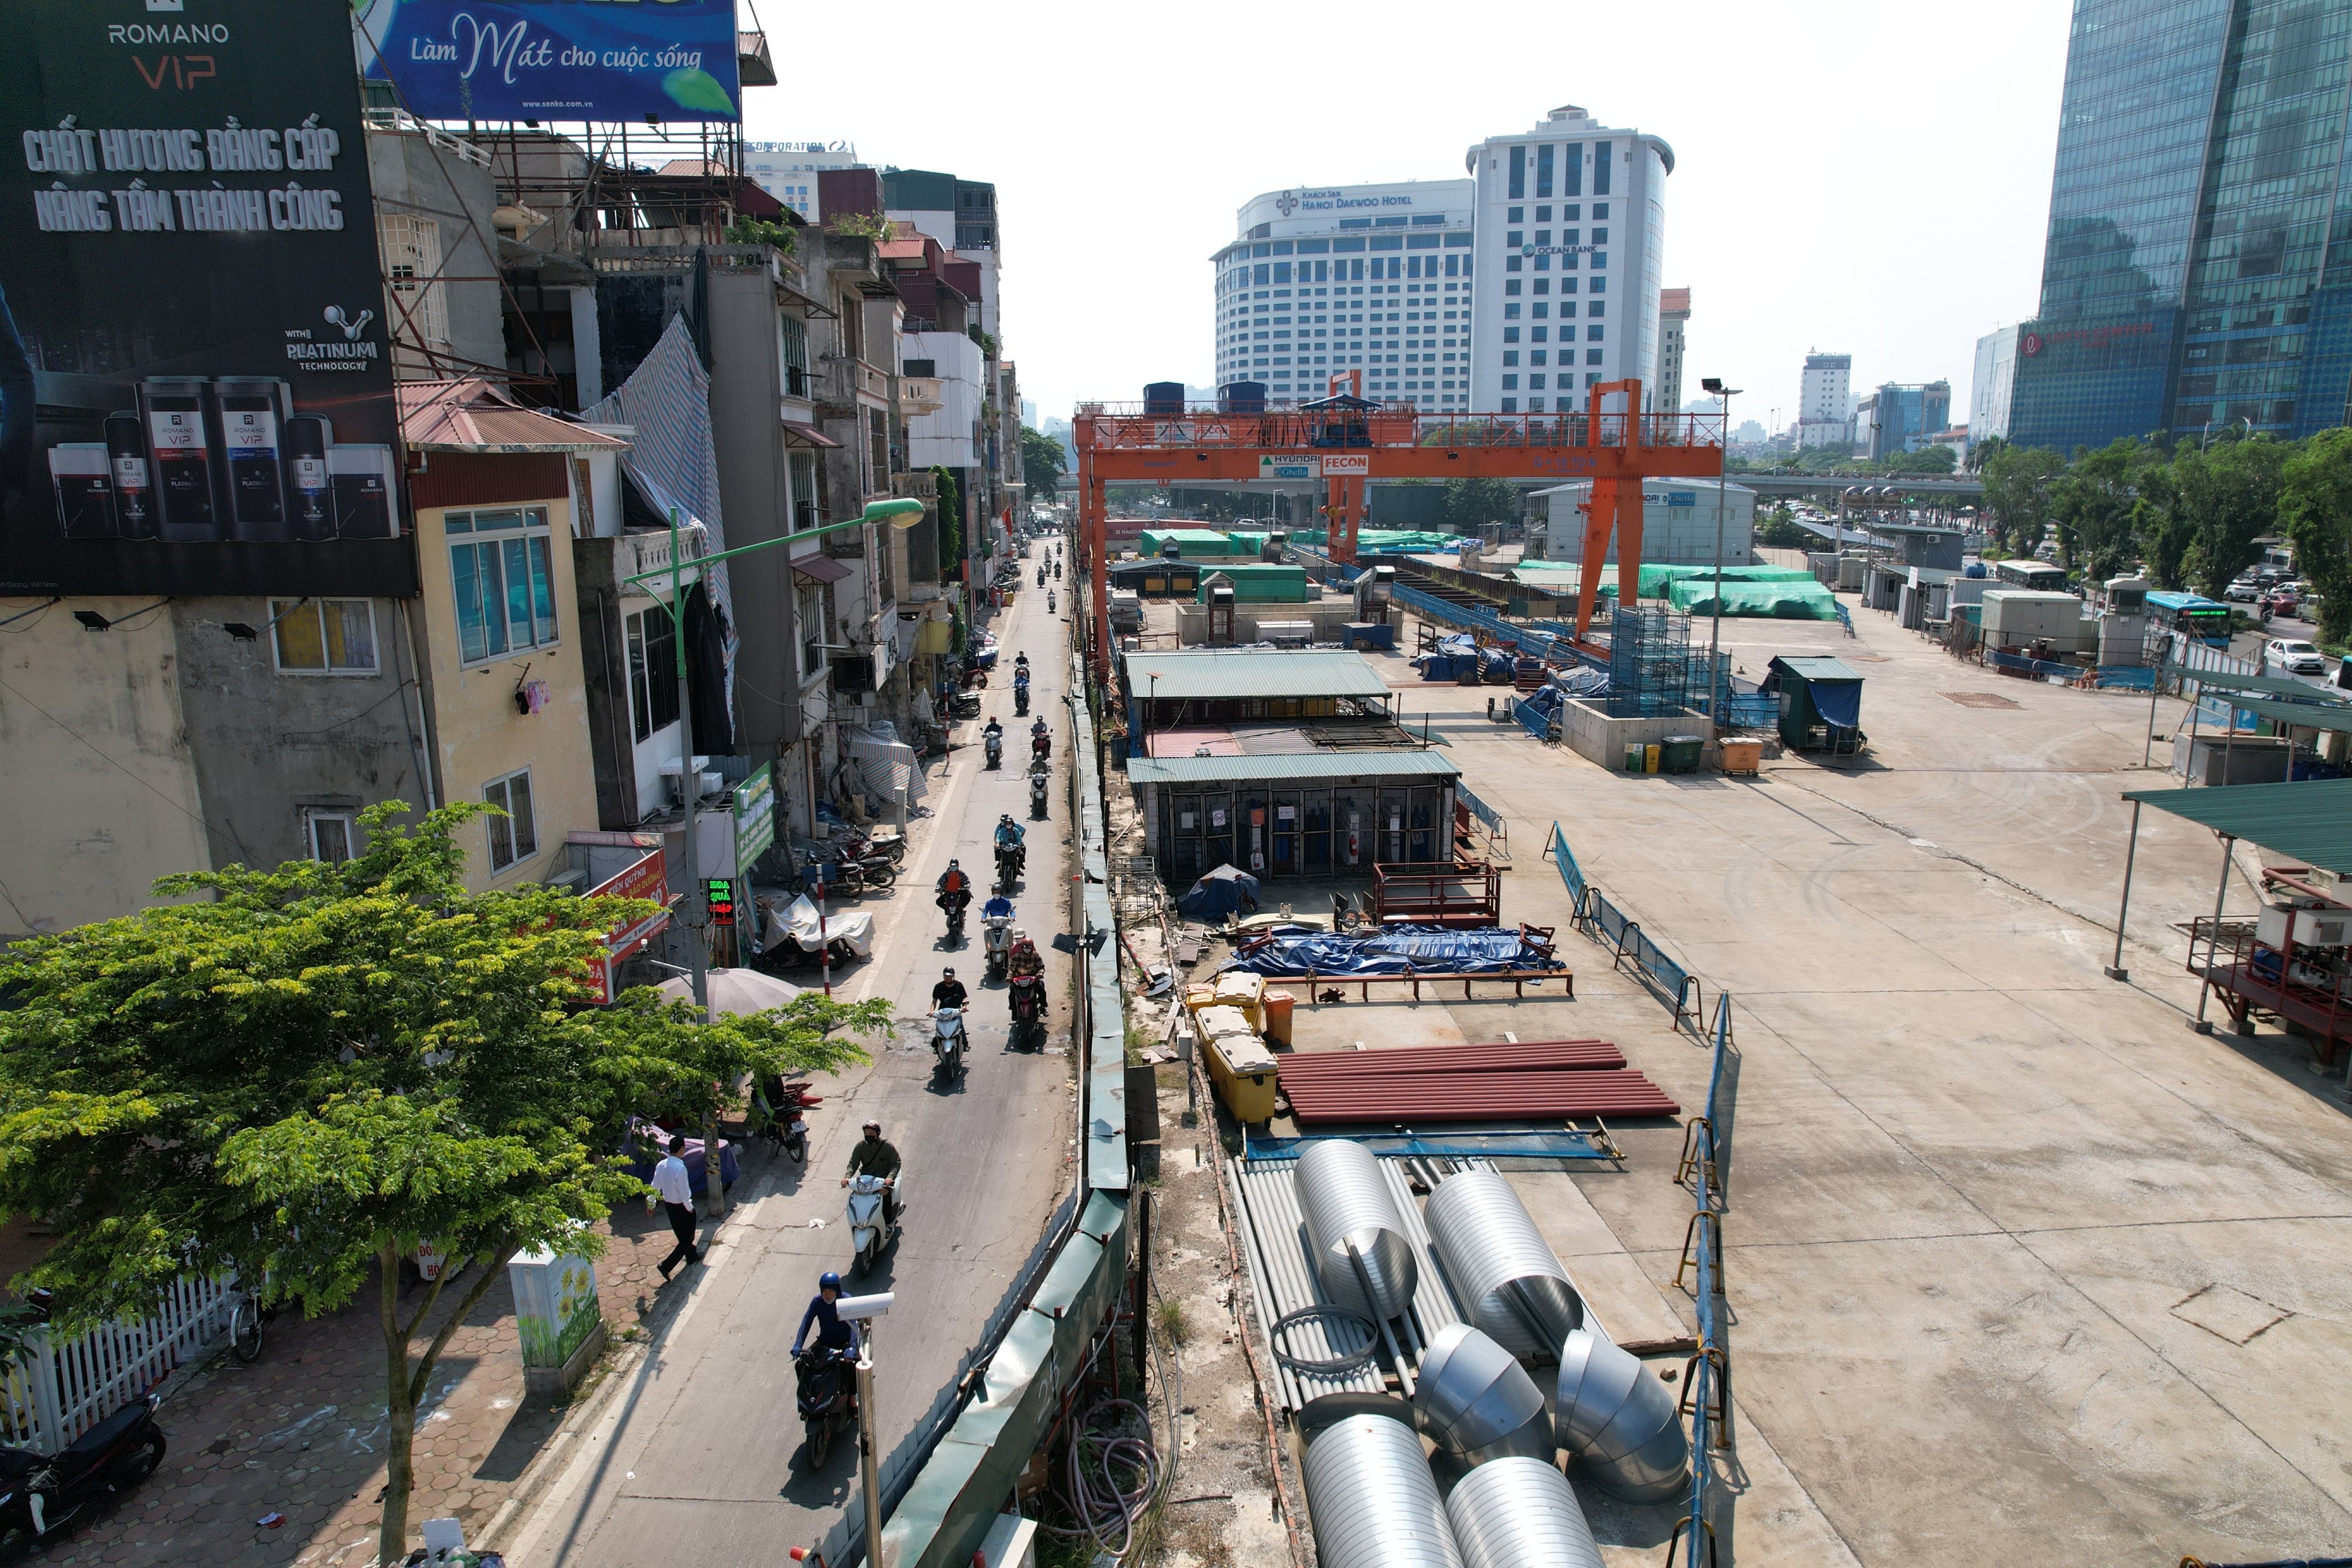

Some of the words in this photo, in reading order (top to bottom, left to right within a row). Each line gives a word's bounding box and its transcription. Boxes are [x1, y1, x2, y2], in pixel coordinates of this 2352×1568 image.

[108, 24, 229, 44] ROMANO
[411, 36, 458, 62] Làm
[451, 13, 554, 84] Mát
[561, 45, 597, 67] cho
[602, 44, 648, 73] cuộc
[653, 43, 702, 71] sống
[132, 55, 216, 90] VIP
[522, 99, 593, 108] www.senko.com.vn
[24, 114, 97, 172] CHẤT
[99, 128, 205, 172] HƯƠNG
[207, 115, 284, 172] ĐẲNG
[284, 113, 340, 171] CẤP
[1302, 191, 1326, 199] KHÁCH
[1327, 190, 1341, 199] SẠN
[34, 180, 113, 231] NÂNG
[111, 177, 176, 231] TẦM
[175, 180, 269, 231] THÀNH
[269, 181, 344, 231] CÔNG
[1302, 200, 1333, 210] HANOI
[1337, 198, 1379, 208] DAEWOO
[1382, 196, 1412, 206] HOTEL
[1538, 246, 1569, 254] OCEAN
[1571, 245, 1597, 253] BANK
[285, 330, 308, 338] WITH
[2092, 323, 2153, 338] CENTER
[286, 342, 376, 360] PLATINUM
[299, 361, 365, 372] TECHNOLOGY
[168, 435, 191, 445] VIP
[240, 435, 262, 445] VIP
[1325, 457, 1366, 468] FECON
[1281, 468, 1307, 476] Ghella
[624, 866, 647, 887] QUỲNH
[709, 880, 730, 889] HOA
[710, 889, 731, 902] QUẢ
[638, 921, 652, 934] SUZUKI
